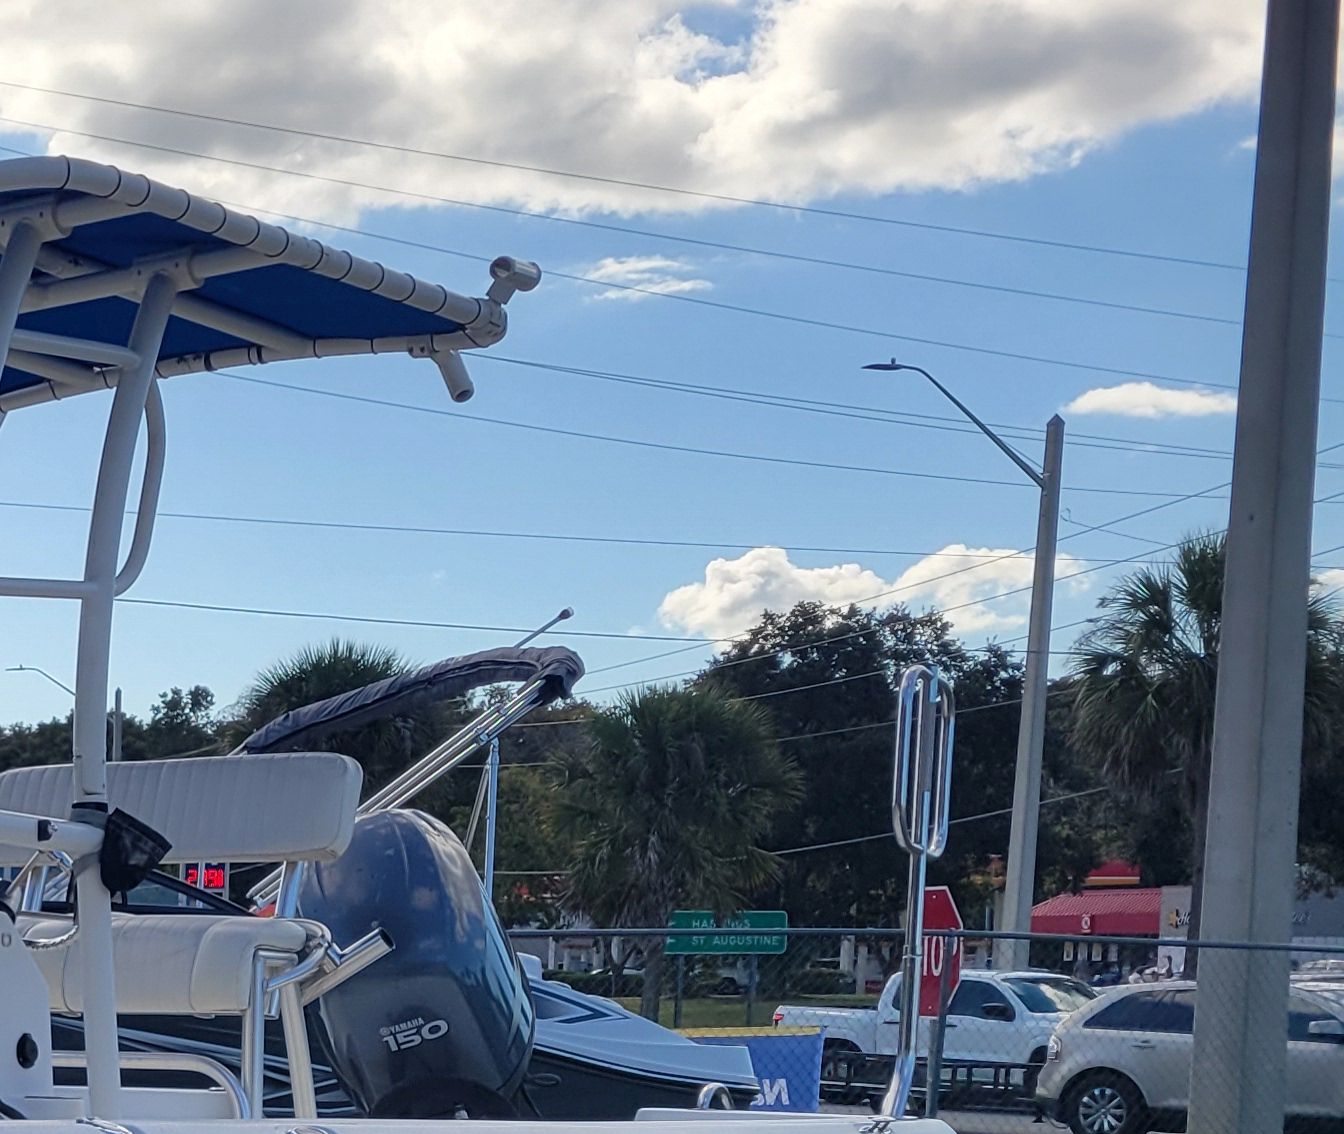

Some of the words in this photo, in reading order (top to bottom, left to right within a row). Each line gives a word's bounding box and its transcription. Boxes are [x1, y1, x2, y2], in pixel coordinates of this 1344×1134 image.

[692, 935, 705, 946] ST
[713, 935, 779, 946] AUGUSTINE
[389, 1017, 425, 1034] YAMAHA
[382, 1019, 449, 1052] 150
